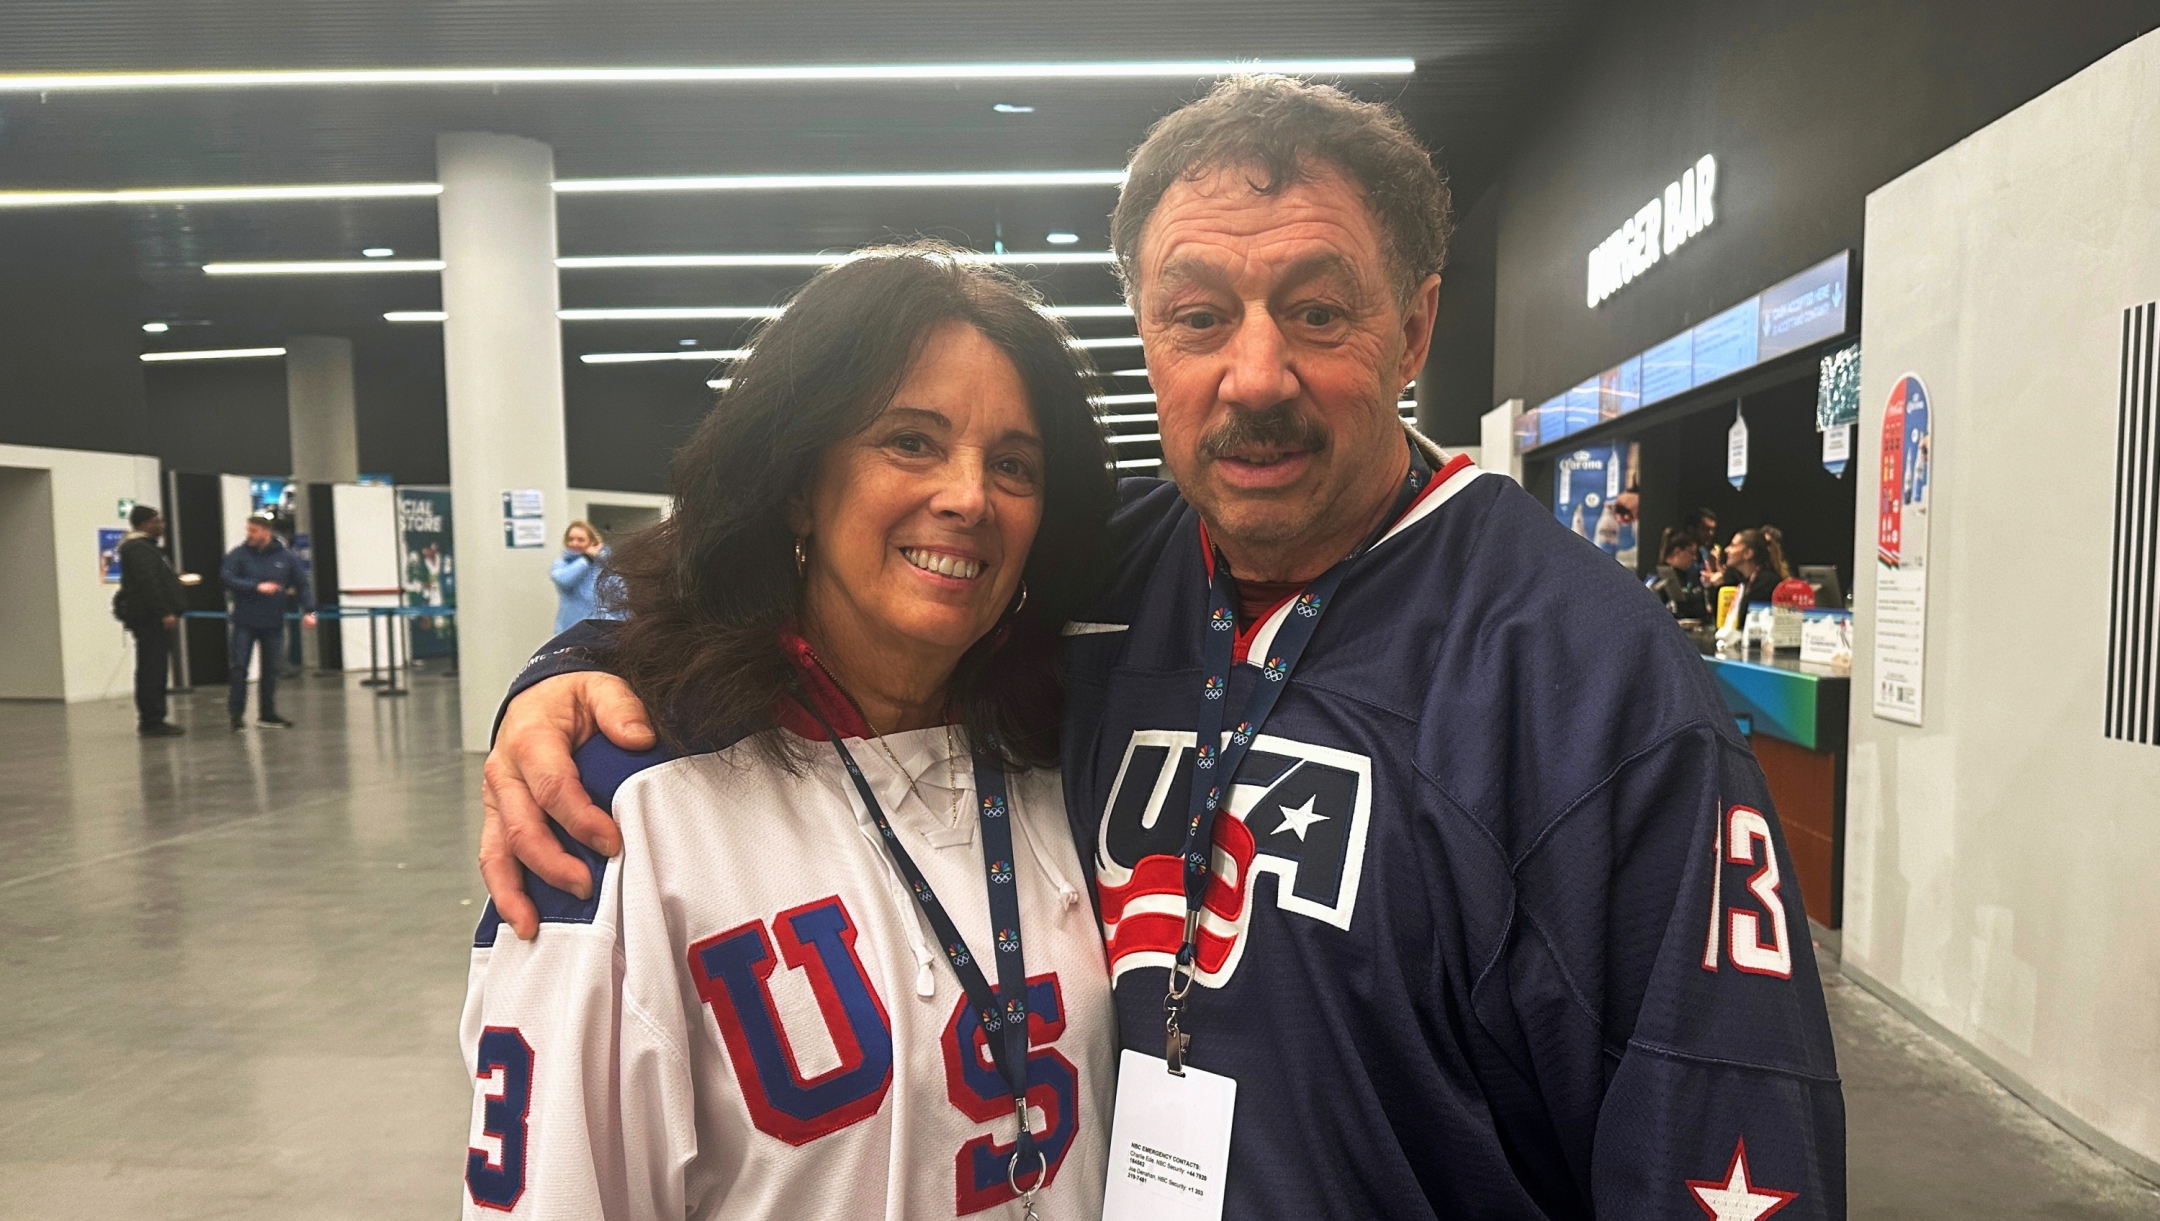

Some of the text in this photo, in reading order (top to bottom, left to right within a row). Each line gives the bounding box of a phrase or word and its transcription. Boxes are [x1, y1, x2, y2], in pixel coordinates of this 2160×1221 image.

[1587, 153, 1716, 309] BURGER BAR
[1095, 730, 1372, 989] USA
[1131, 1142, 1201, 1170] NBC EMERGENCY CONTACTS:
[1156, 1159, 1167, 1168] NBC
[1167, 1162, 1186, 1175] Security
[1157, 1175, 1168, 1183] NBC
[1169, 1179, 1186, 1191] Security
